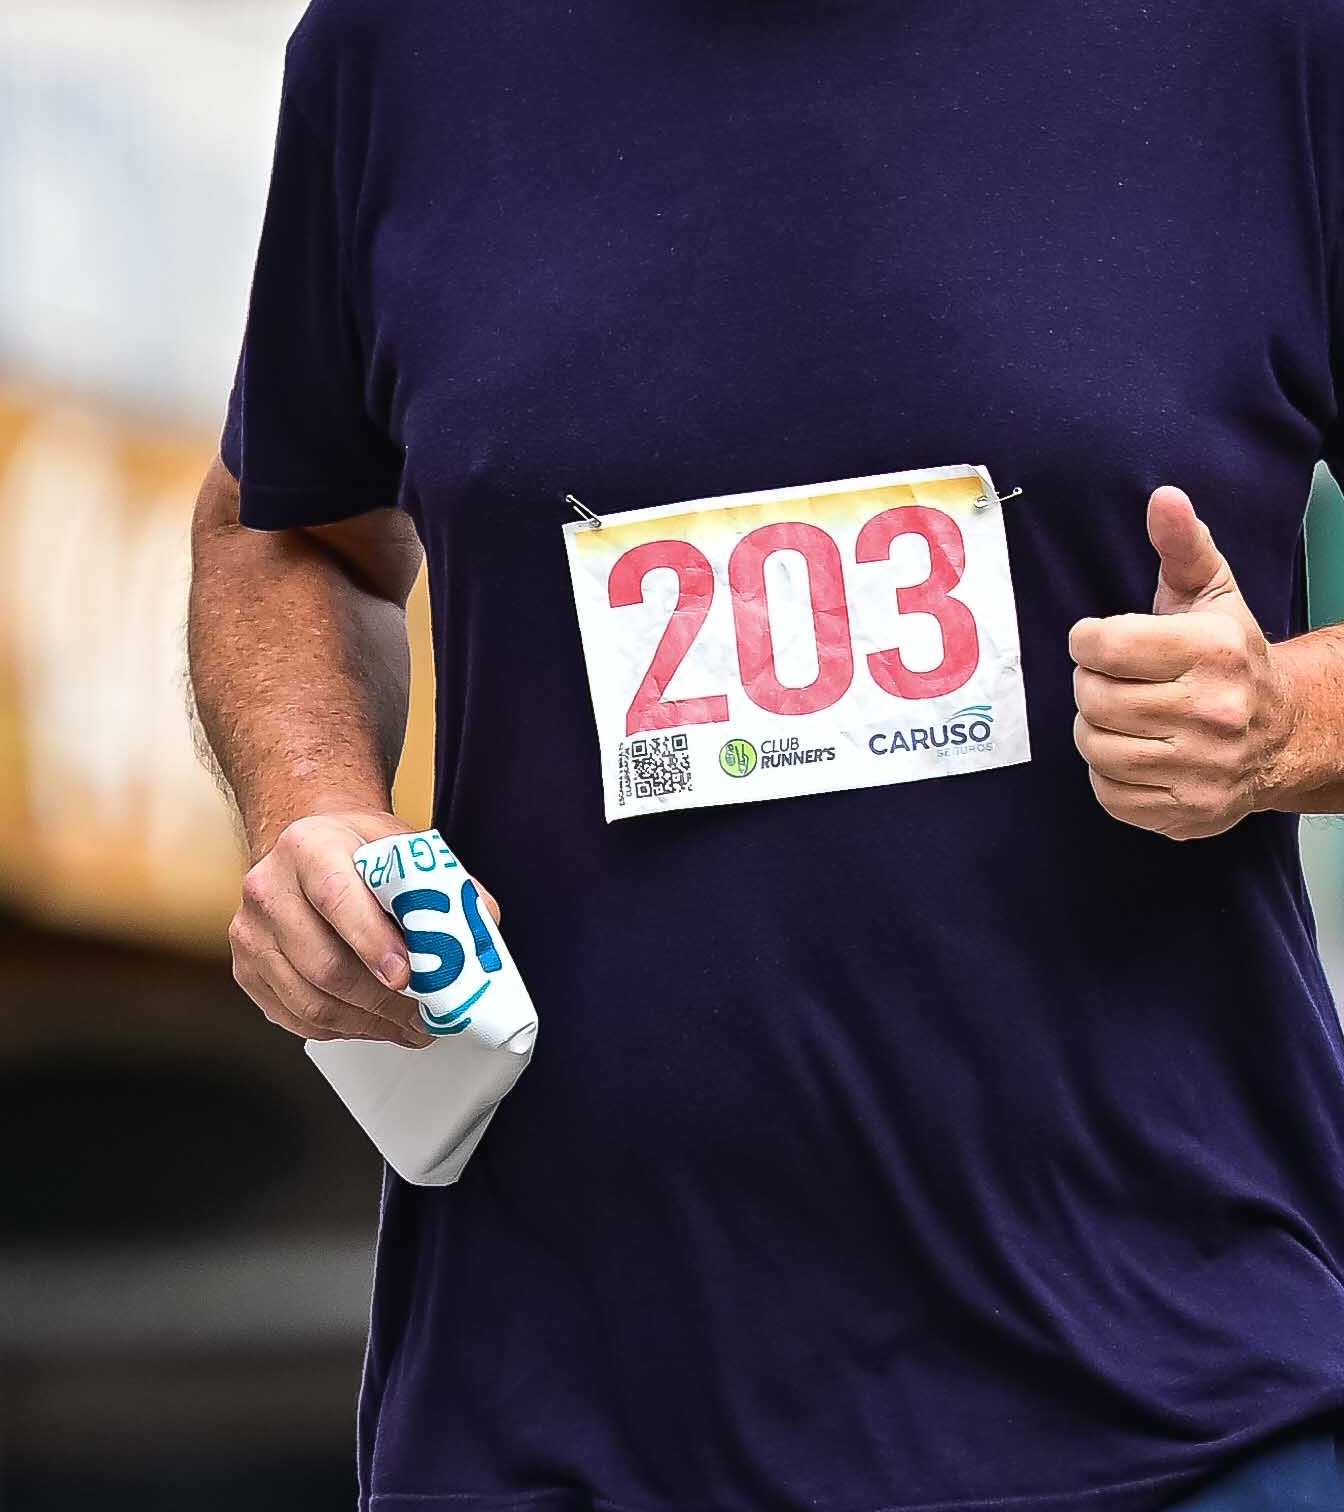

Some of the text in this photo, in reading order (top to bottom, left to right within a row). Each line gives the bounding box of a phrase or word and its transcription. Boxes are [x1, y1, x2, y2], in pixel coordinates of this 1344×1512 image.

[608, 505, 979, 736] 203
[760, 737, 800, 755] CLUB
[868, 720, 991, 756] CARUSO
